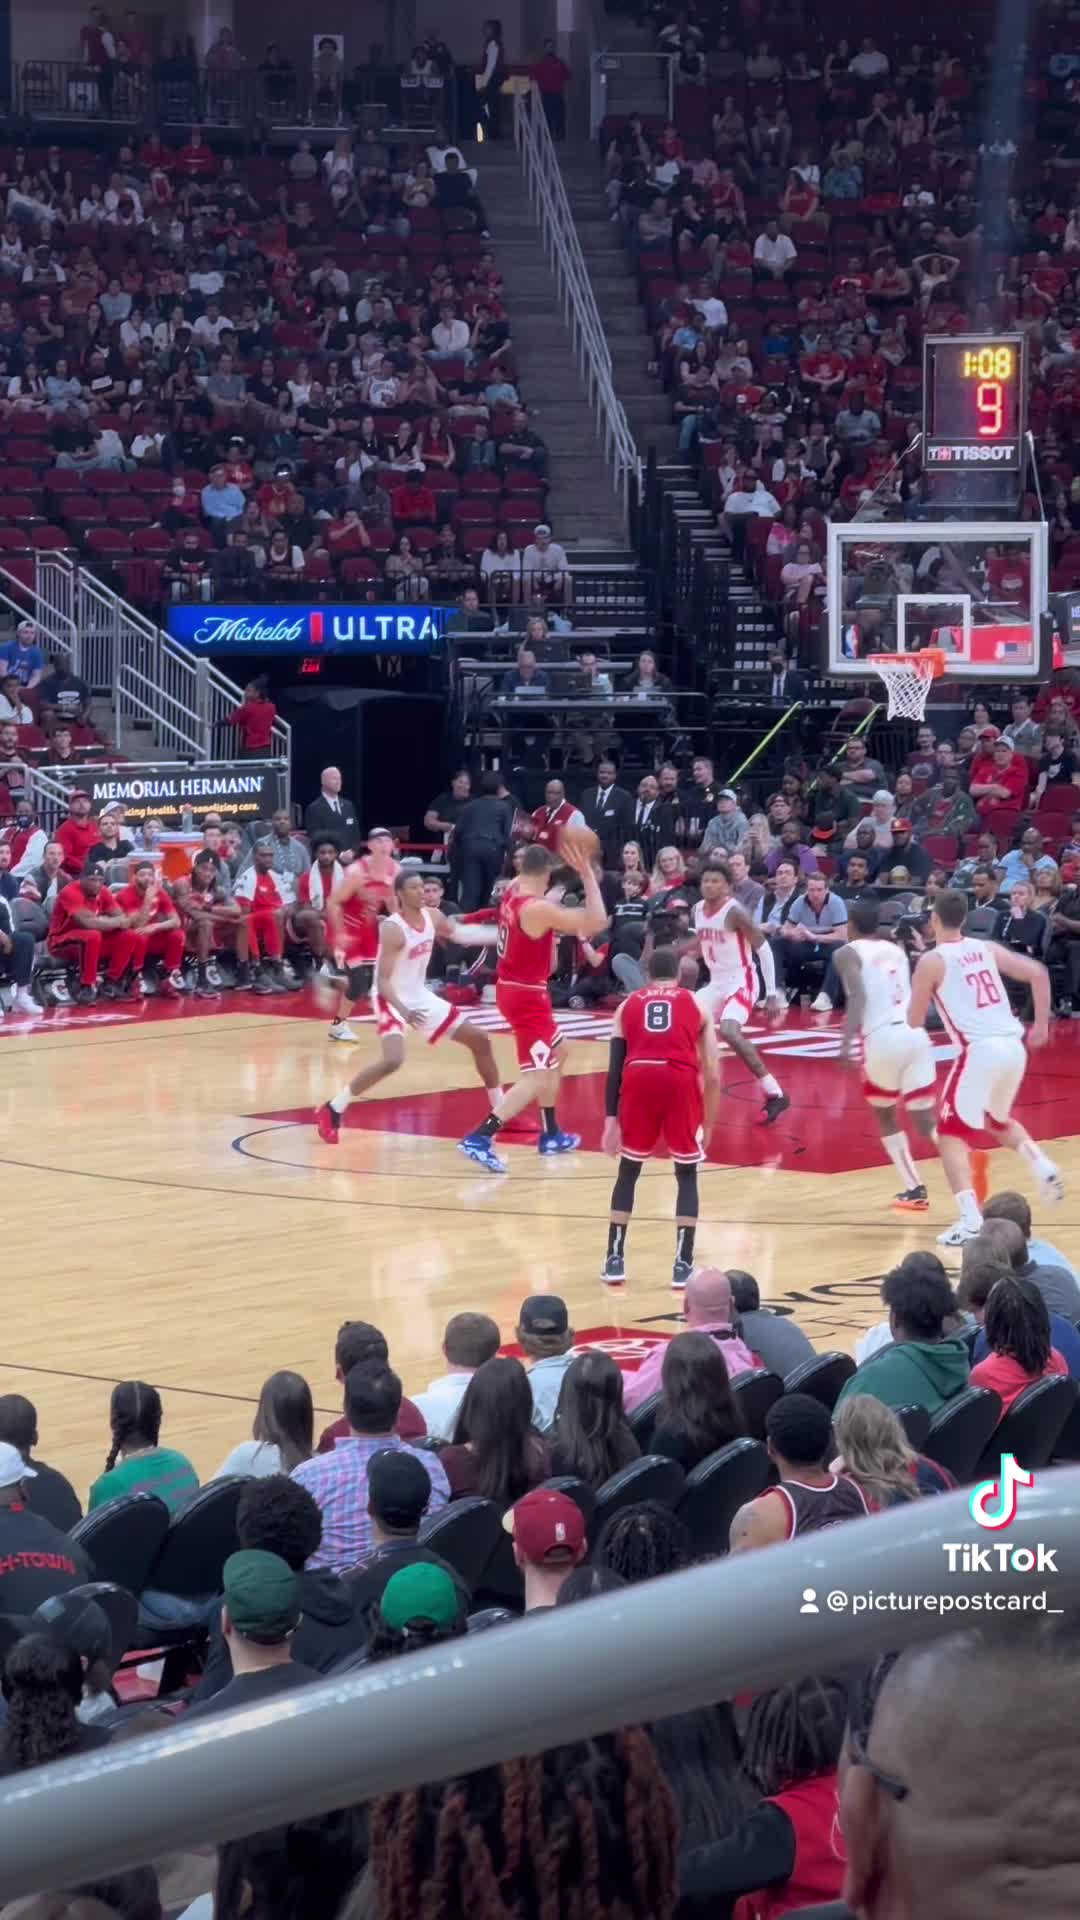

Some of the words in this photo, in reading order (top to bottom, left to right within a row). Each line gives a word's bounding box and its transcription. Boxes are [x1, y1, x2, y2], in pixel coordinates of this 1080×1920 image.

[964, 347, 1011, 379] 1:08
[977, 382, 1002, 434] 9
[951, 446, 1015, 461] TISSOT
[194, 616, 304, 644] Michelob
[332, 616, 438, 641] ULTRA
[93, 781, 177, 800] MEMORIAL
[180, 776, 263, 796] HERMANN
[965, 969, 1001, 1008] 28
[644, 1000, 671, 1032] 8
